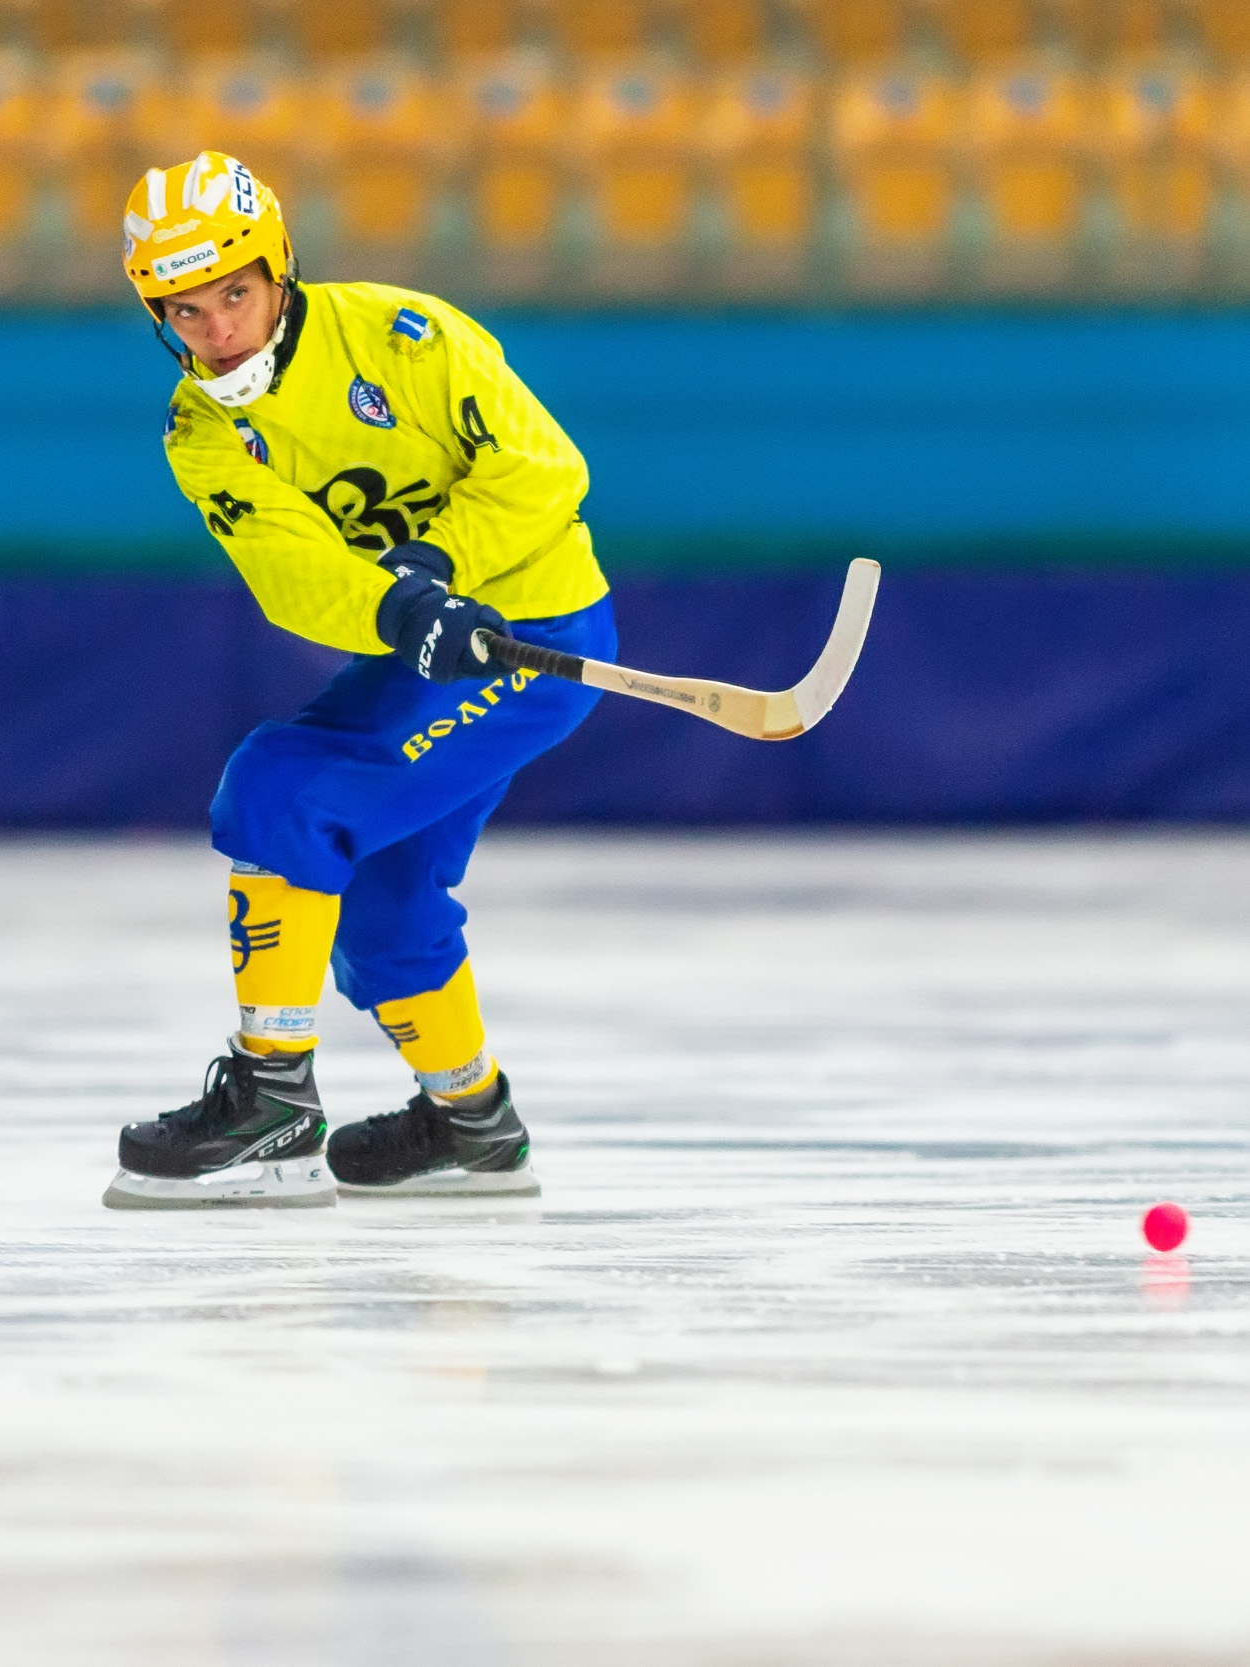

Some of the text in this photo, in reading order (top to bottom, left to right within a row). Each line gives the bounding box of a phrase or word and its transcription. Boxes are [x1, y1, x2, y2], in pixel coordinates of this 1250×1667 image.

[170, 248, 216, 271] ŠKODA
[418, 618, 444, 680] CCM
[258, 1115, 310, 1158] CCM
